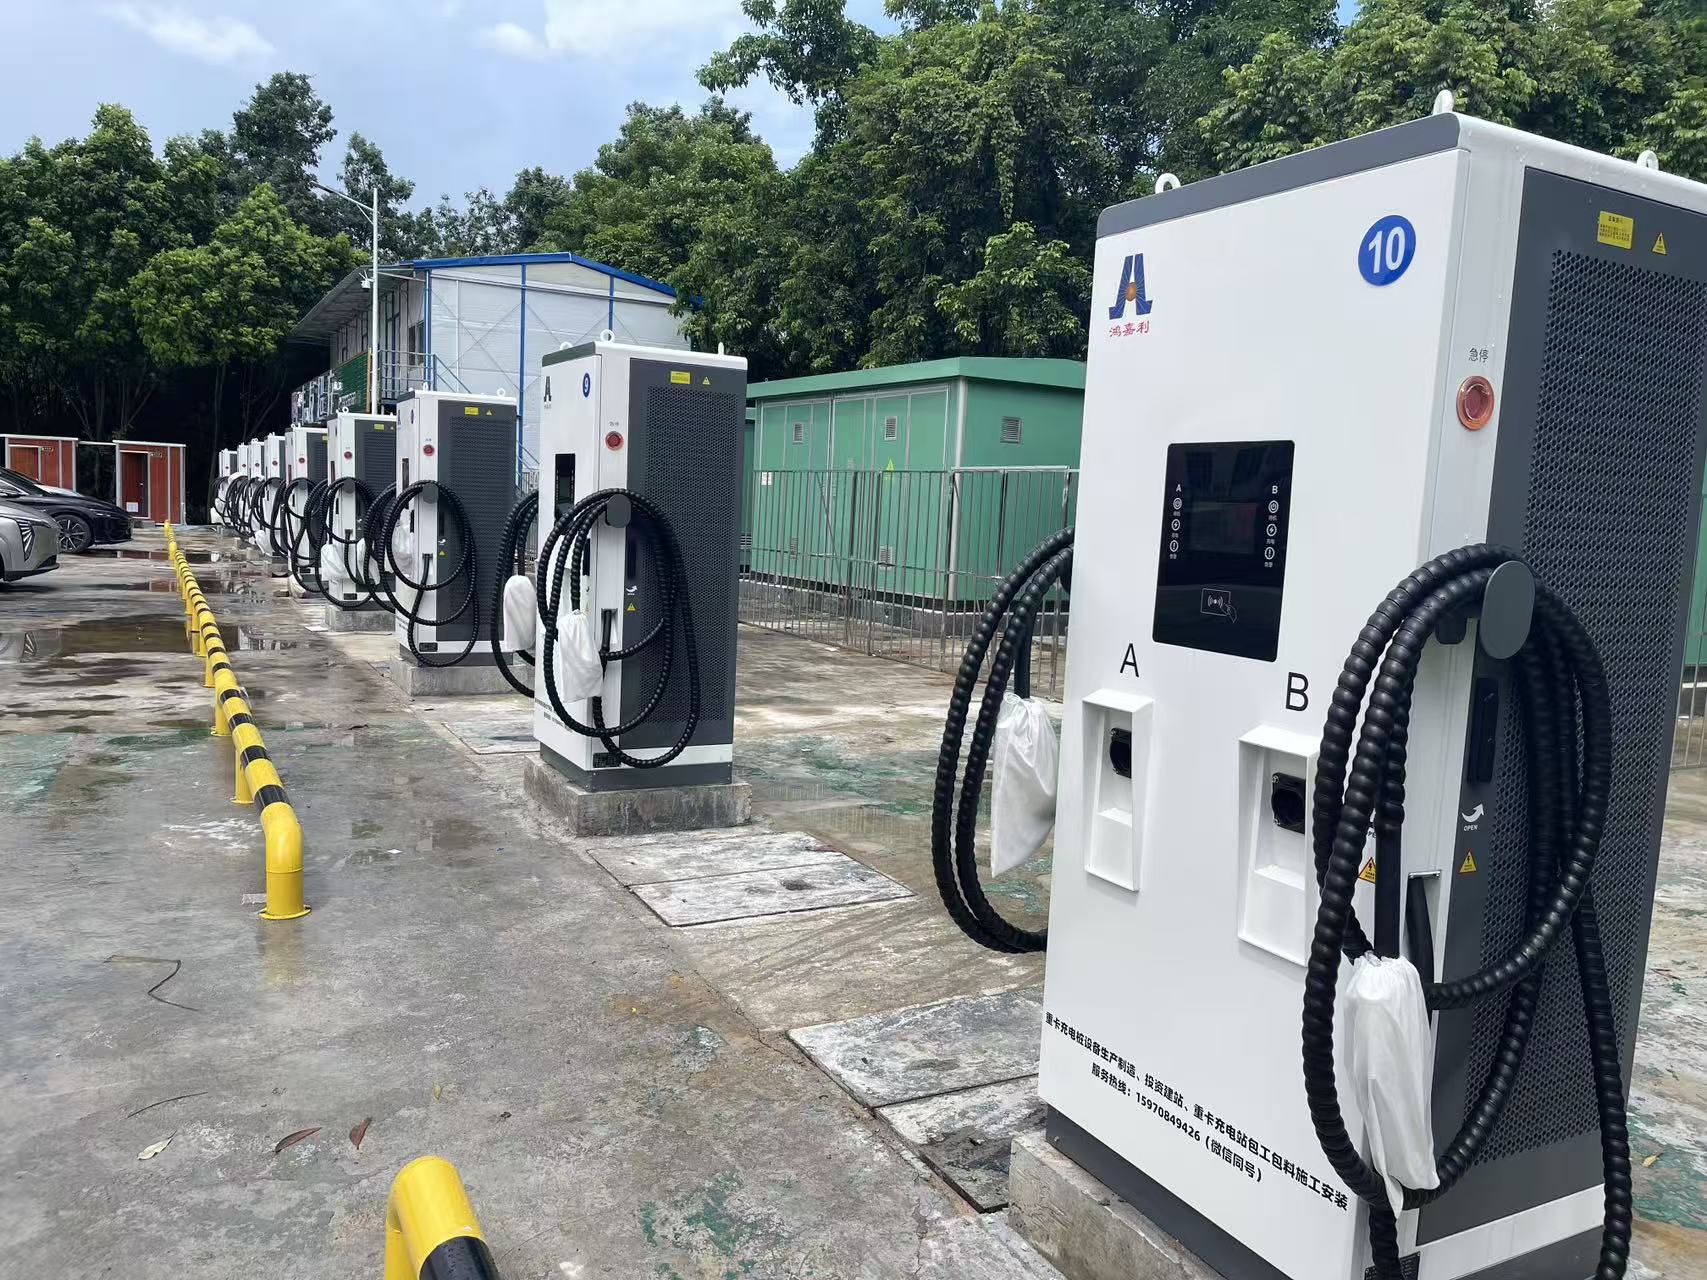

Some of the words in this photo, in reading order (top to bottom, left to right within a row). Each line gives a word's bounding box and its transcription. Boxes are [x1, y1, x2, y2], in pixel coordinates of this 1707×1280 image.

[1368, 226, 1406, 274] 10
[1109, 320, 1150, 337] 鸿嘉利
[1468, 347, 1489, 363] 急停
[1175, 484, 1182, 492] A
[1271, 485, 1279, 494] B
[1120, 643, 1140, 678] A
[1285, 671, 1310, 712] B
[1463, 824, 1479, 832] OPEN
